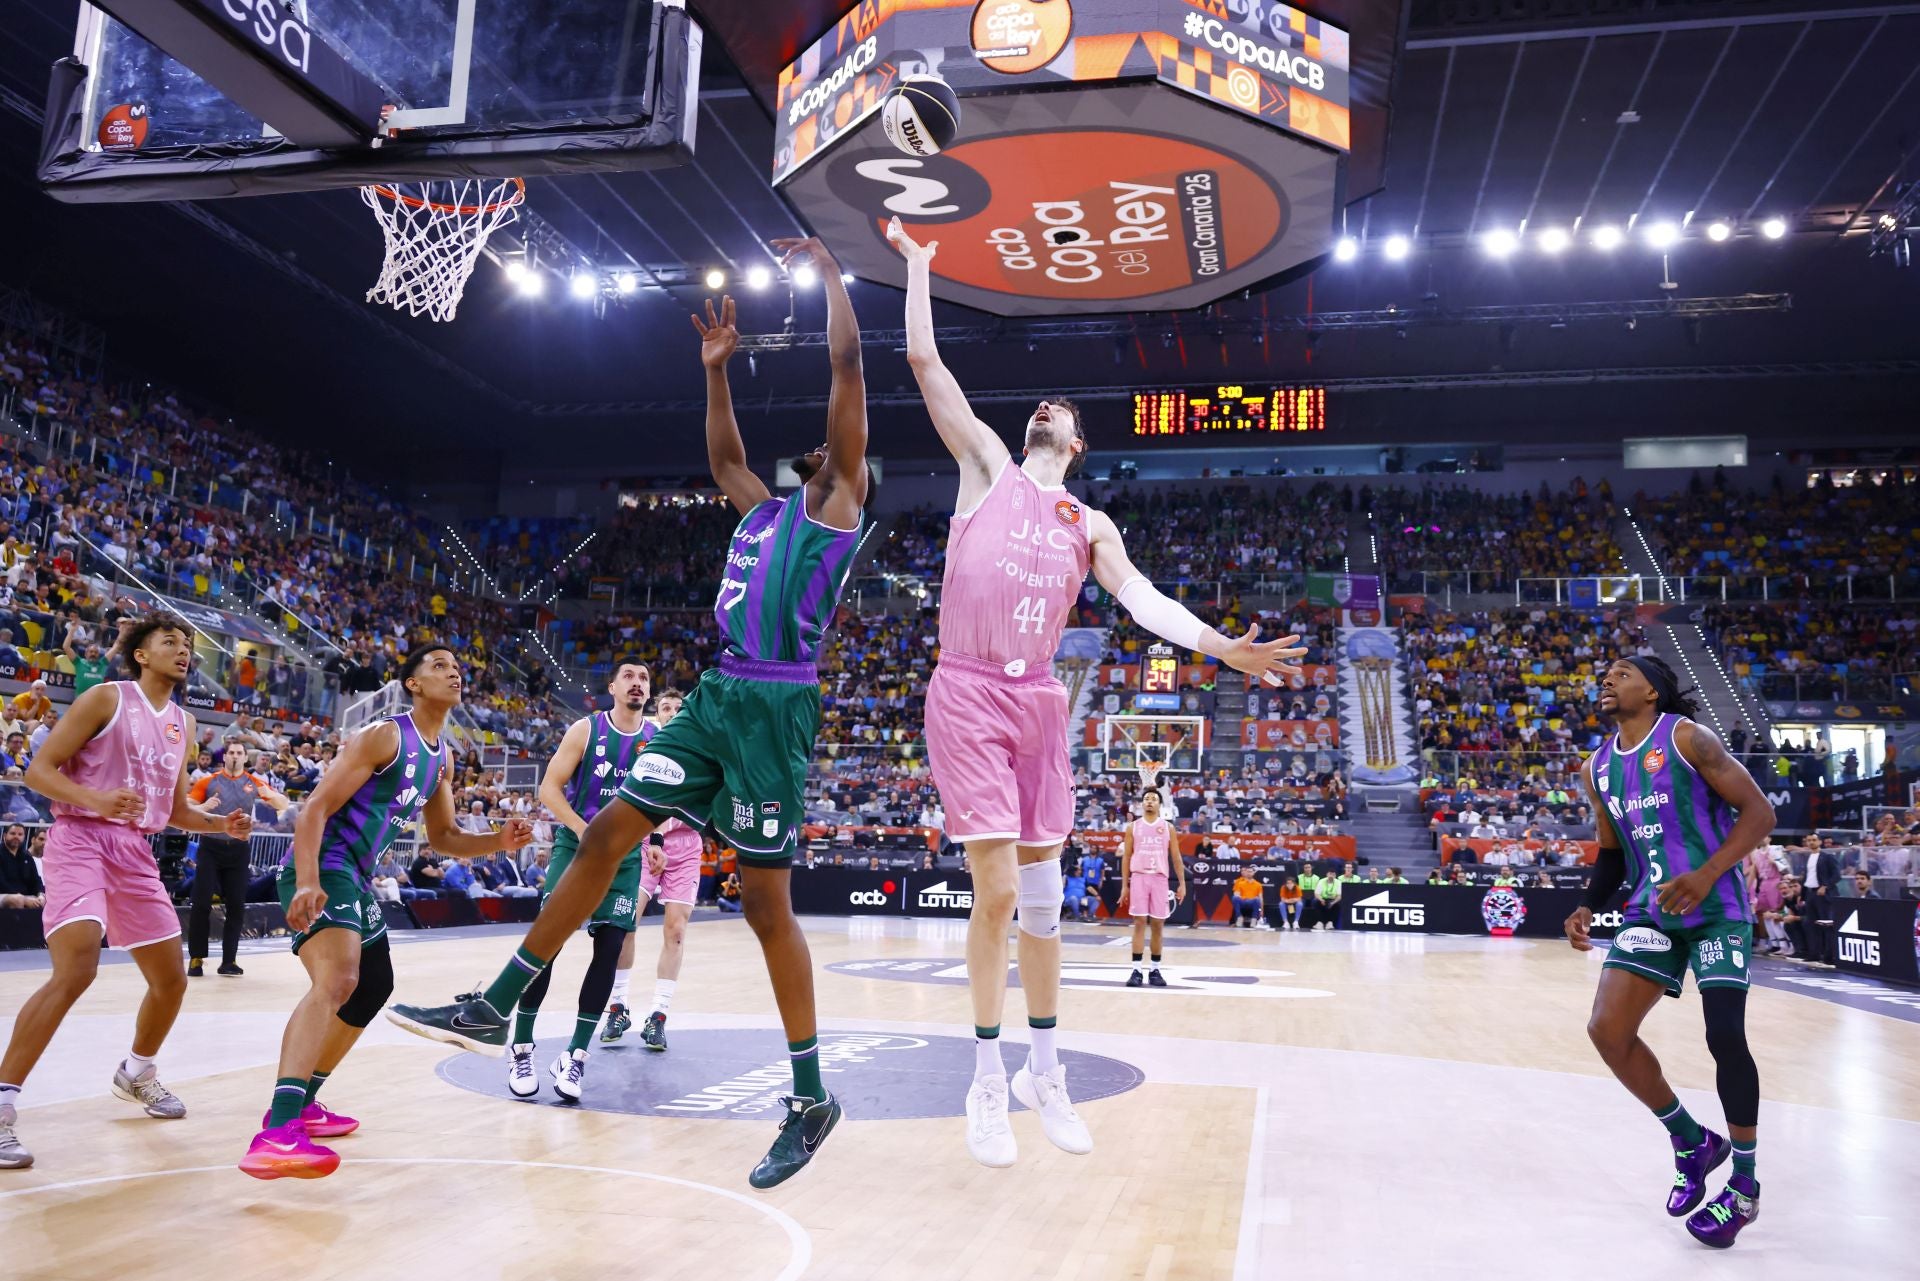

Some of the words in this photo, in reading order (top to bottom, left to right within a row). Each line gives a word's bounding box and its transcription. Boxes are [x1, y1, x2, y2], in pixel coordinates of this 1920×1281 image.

[986, 13, 1035, 30] Copa
[1007, 29, 1042, 46] Rey
[1183, 11, 1325, 91] #CopaACB
[788, 35, 877, 126] #CopaACB
[107, 126, 132, 134] Copa
[1185, 173, 1211, 196] '25
[1109, 181, 1175, 244] Rey
[1186, 195, 1218, 249] Canaria
[985, 227, 1038, 270] acb
[1032, 200, 1104, 283] Copa
[1109, 249, 1150, 275] del
[1196, 249, 1220, 276] Gran
[1218, 386, 1242, 398] 5:00
[1194, 405, 1208, 416] 30
[1248, 403, 1263, 415] 29
[1009, 519, 1071, 550] J&C
[1013, 596, 1047, 634] 44
[1148, 647, 1173, 655] LOTUS
[1151, 659, 1176, 671] 5:00
[1146, 670, 1172, 690] 24
[131, 745, 176, 770] J&C
[638, 758, 683, 780] amadesa
[1622, 791, 1669, 813] Unicaja
[1648, 850, 1663, 883] 5
[850, 889, 887, 906] acb
[918, 893, 972, 908] LOTUS
[1352, 907, 1424, 925] LOTUS
[1590, 910, 1624, 927] acb
[1838, 937, 1880, 966] LOTUS
